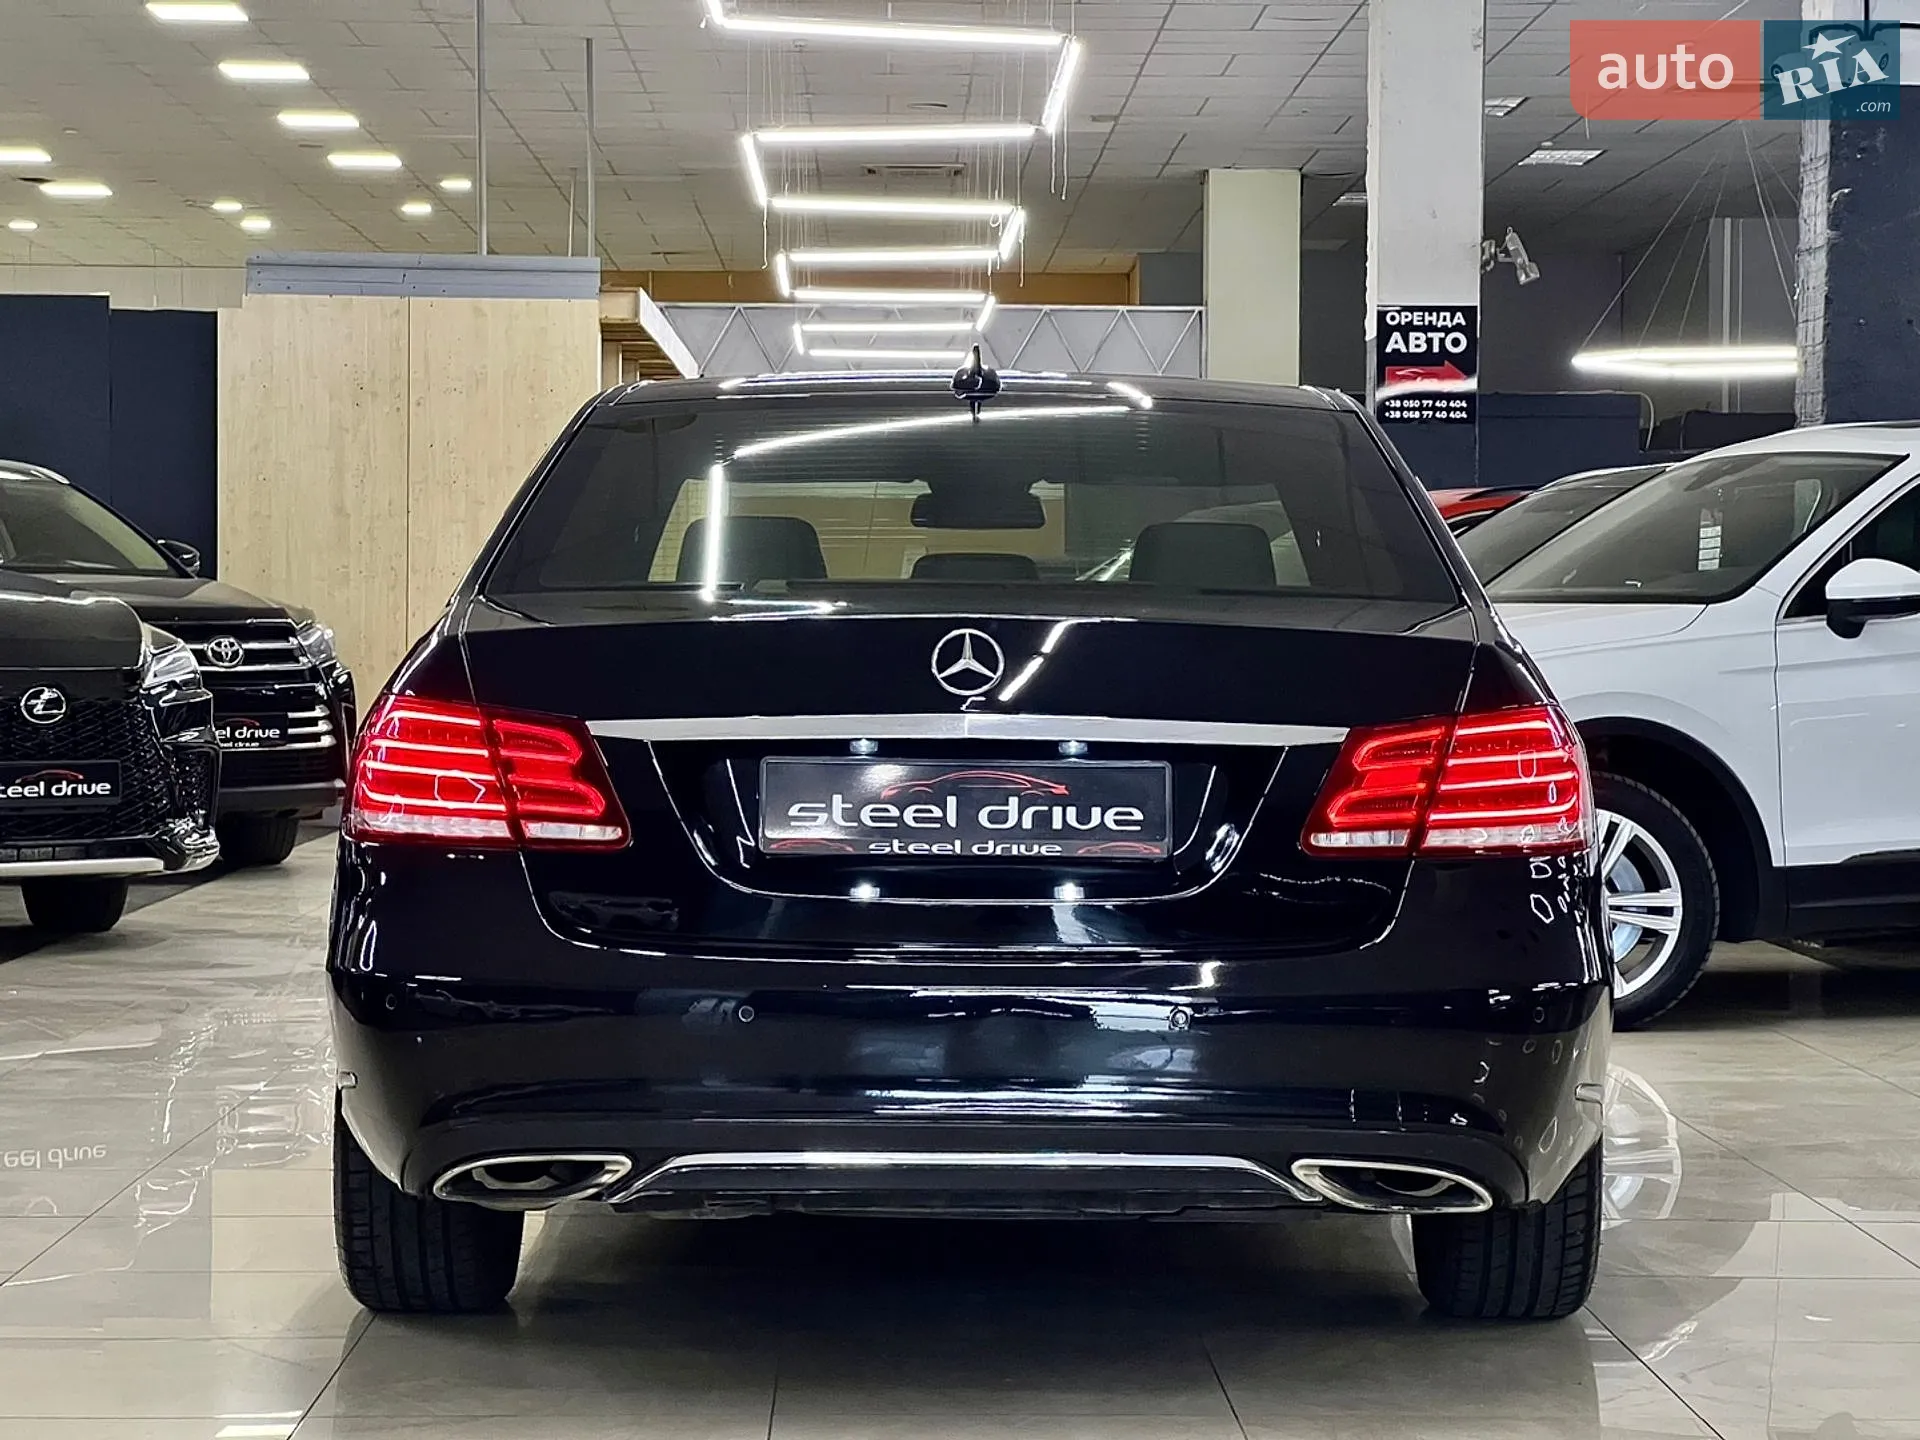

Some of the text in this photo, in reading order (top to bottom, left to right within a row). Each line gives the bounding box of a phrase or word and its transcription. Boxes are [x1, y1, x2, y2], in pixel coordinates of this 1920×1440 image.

[1386, 311, 1466, 328] ОРЕНДА
[1385, 331, 1468, 353] АВТО
[1421, 400, 1433, 408] 77
[1434, 400, 1447, 408] 40
[1448, 400, 1467, 408] 404
[1421, 410, 1433, 419] 77
[1434, 410, 1447, 419] 40
[1448, 410, 1467, 419] 404
[234, 726, 280, 738] drive
[51, 780, 111, 796] drive
[787, 794, 1144, 831] steel drive
[868, 839, 1063, 856] steel drive
